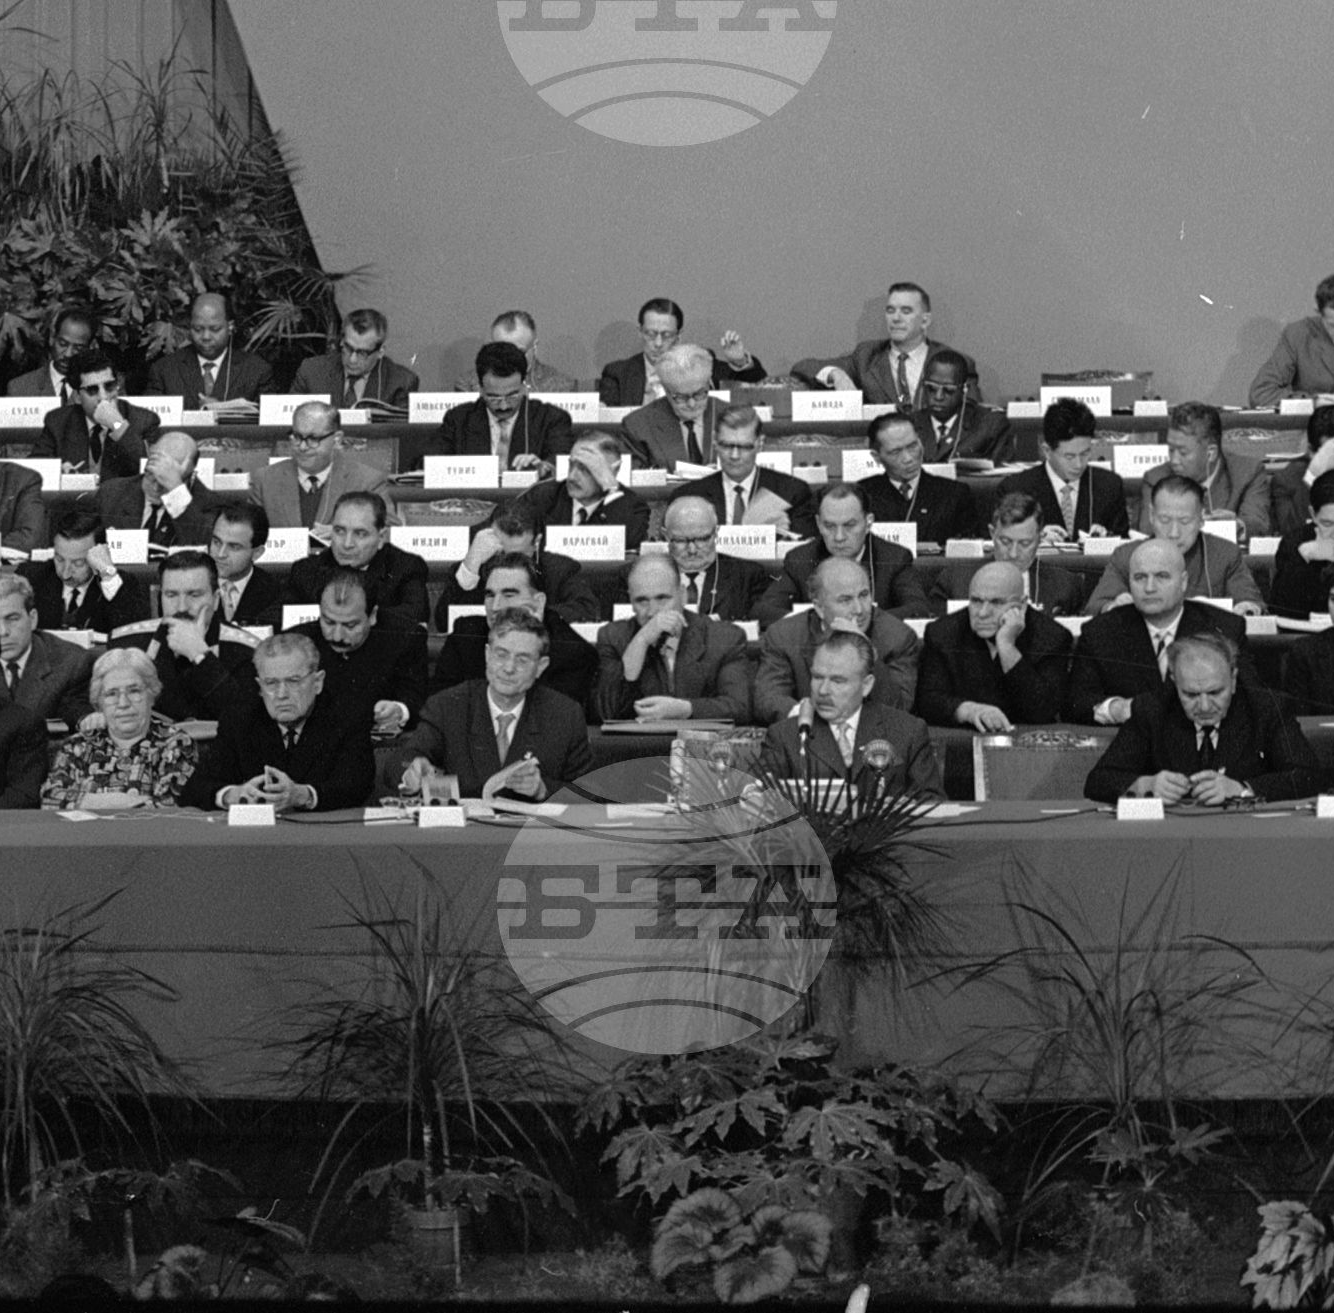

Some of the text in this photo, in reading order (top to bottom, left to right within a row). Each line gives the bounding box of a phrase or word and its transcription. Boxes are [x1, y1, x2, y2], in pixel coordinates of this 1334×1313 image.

[811, 400, 844, 409] КАНАДА
[411, 537, 448, 548] ИНДИЯ
[562, 535, 609, 547] ПАРАГВАЙ
[715, 536, 767, 546] ИНЛАНДИЯ
